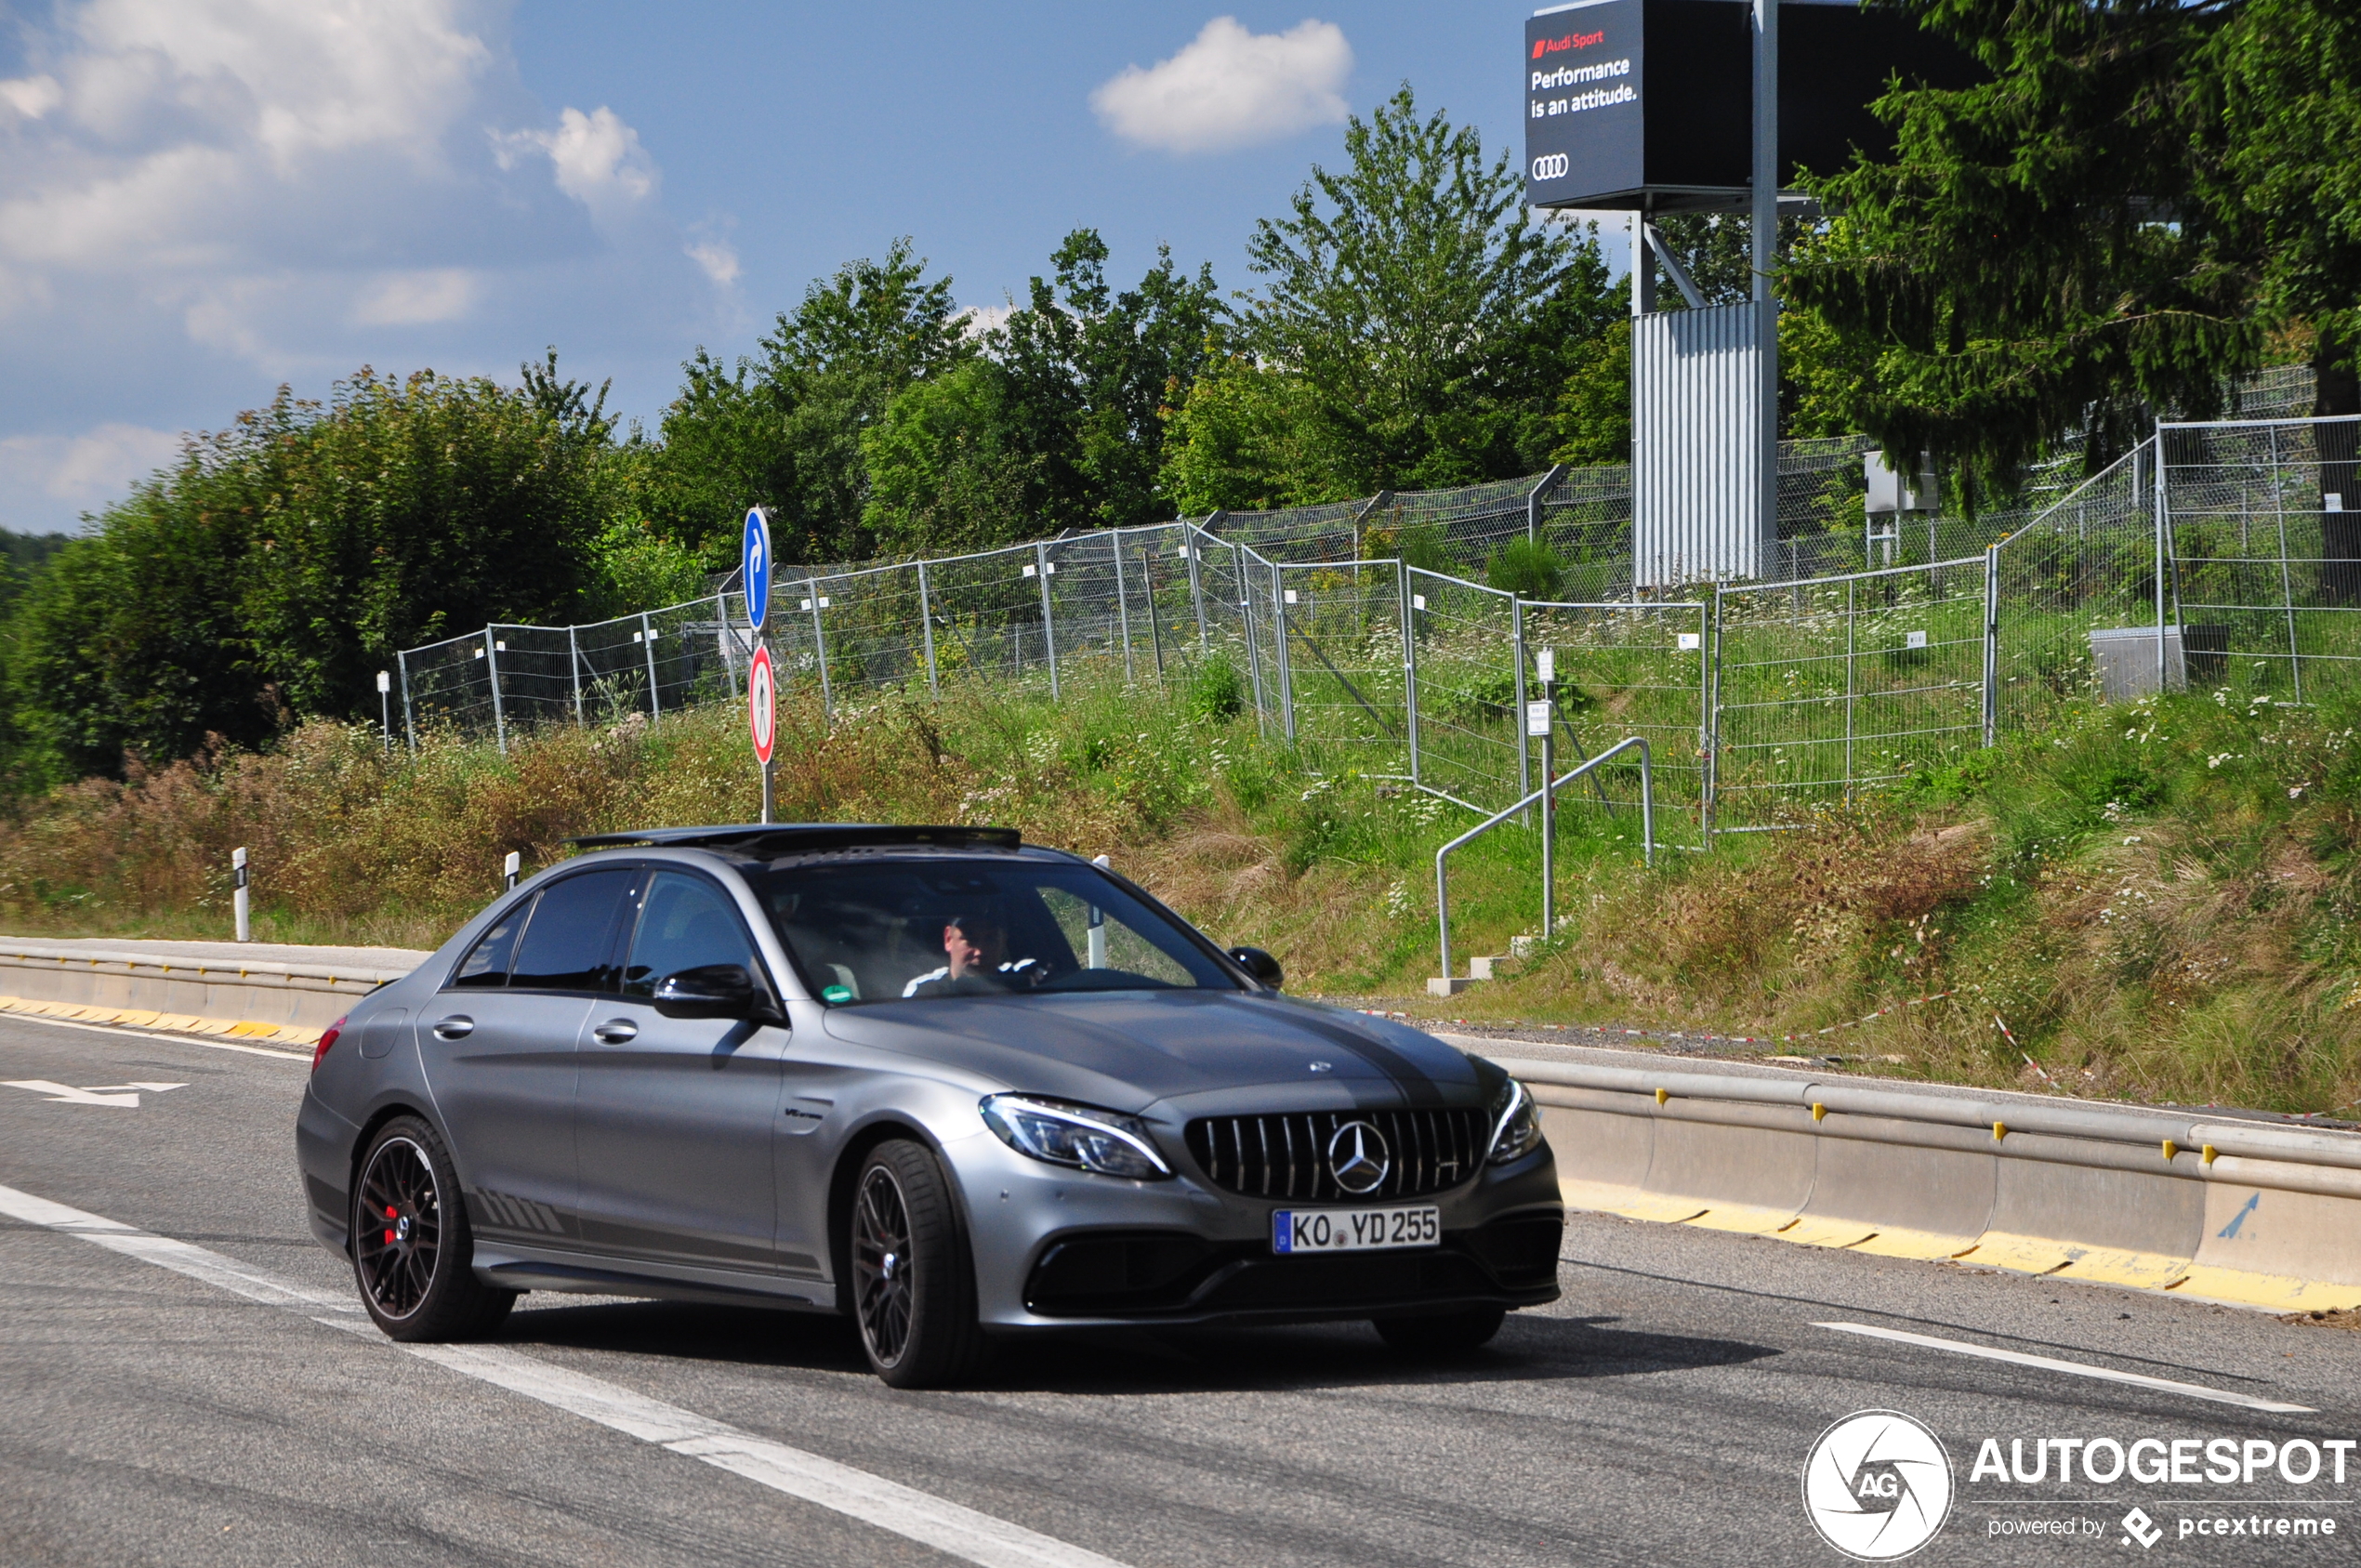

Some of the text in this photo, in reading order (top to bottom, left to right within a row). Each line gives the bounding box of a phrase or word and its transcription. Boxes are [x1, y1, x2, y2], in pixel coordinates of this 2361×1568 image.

[1546, 30, 1604, 53] Audi Sport
[1532, 59, 1630, 91] Performance
[1532, 83, 1638, 118] is an attitude.
[1294, 1214, 1331, 1247] KO
[1352, 1212, 1385, 1245] YD
[1391, 1209, 1437, 1242] 255
